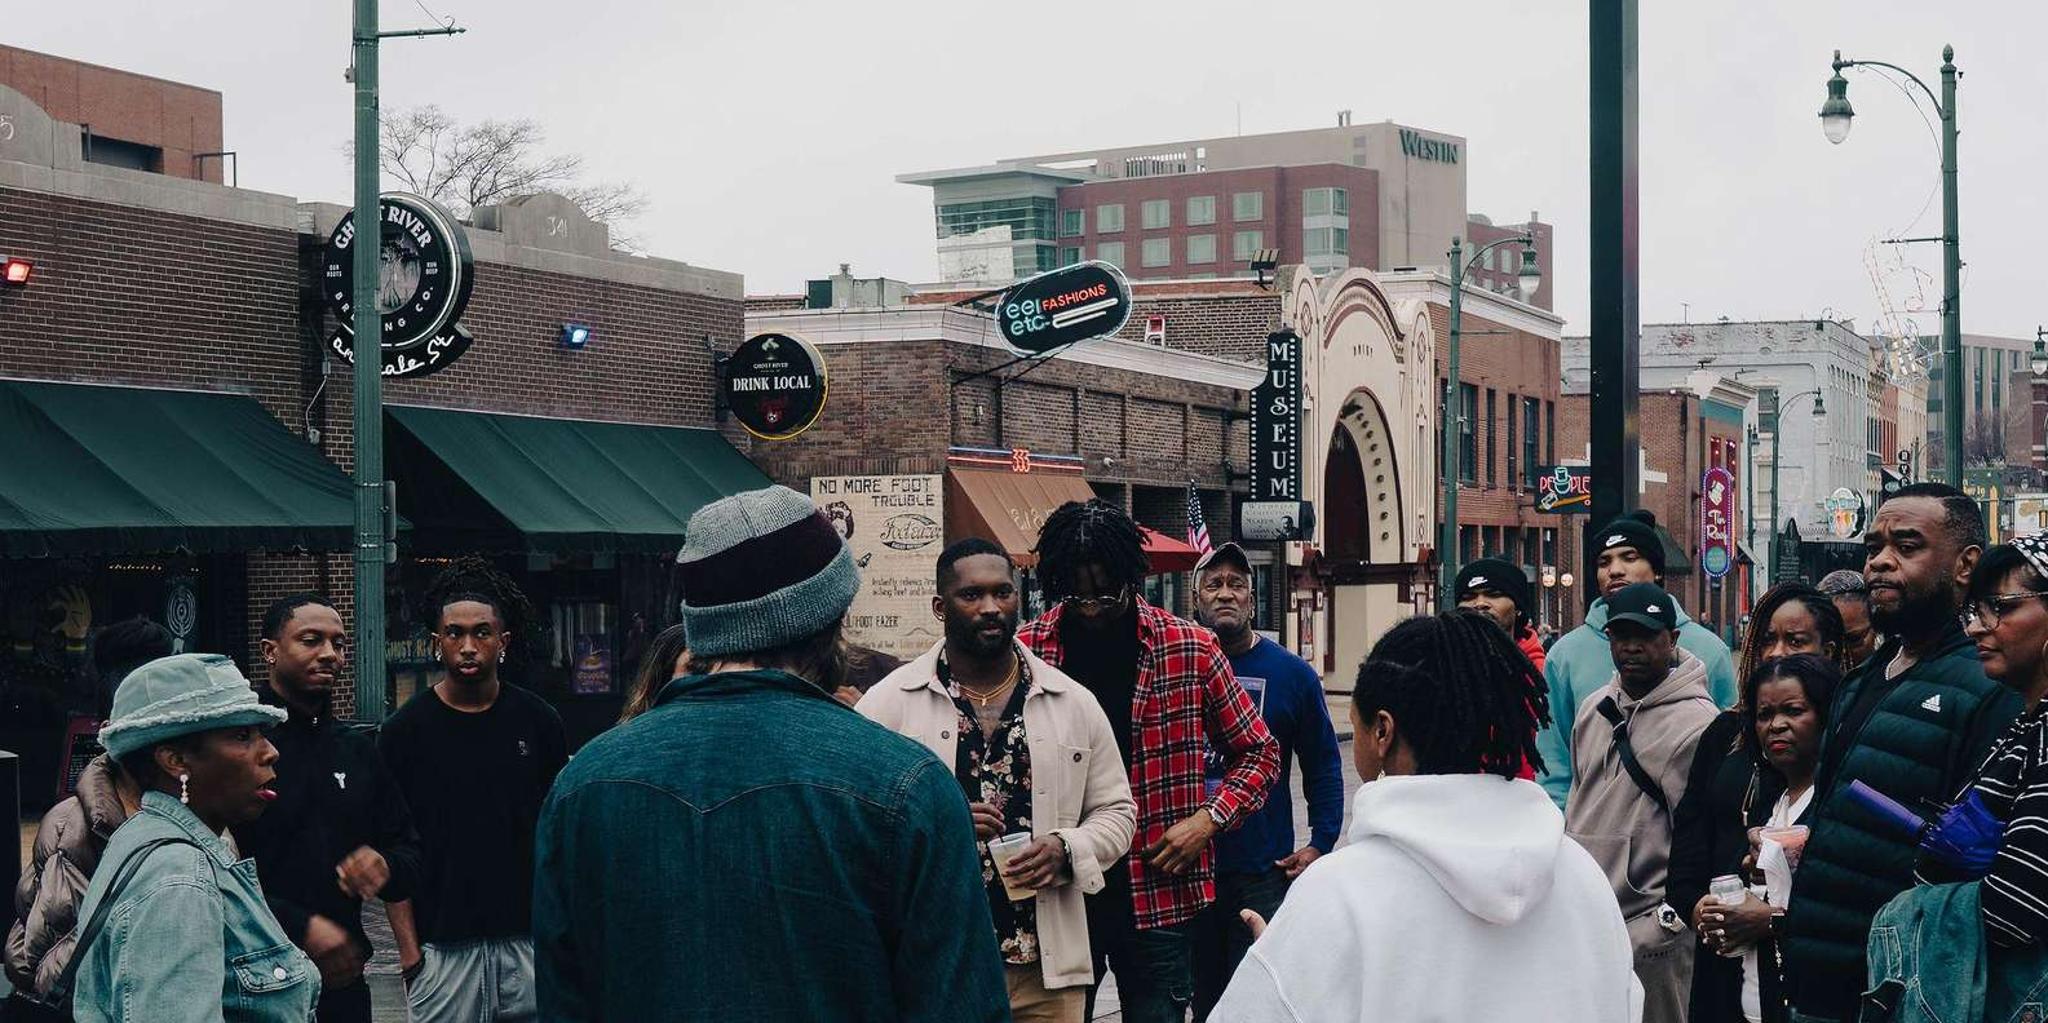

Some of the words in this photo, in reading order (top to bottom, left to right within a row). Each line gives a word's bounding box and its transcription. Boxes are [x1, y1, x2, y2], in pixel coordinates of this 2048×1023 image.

[387, 205, 432, 249] RIVER
[415, 286, 434, 312] CO.
[1006, 299, 1041, 320] eel
[1042, 283, 1107, 311] FASHIONS
[733, 377, 770, 391] DRINK
[774, 375, 811, 390] LOCAL
[1270, 342, 1289, 497] MUSEUM
[1012, 447, 1031, 473] 333
[819, 479, 837, 493] NO
[844, 479, 881, 493] MORE
[891, 477, 932, 492] FOOT
[871, 493, 935, 507] TROUBLE
